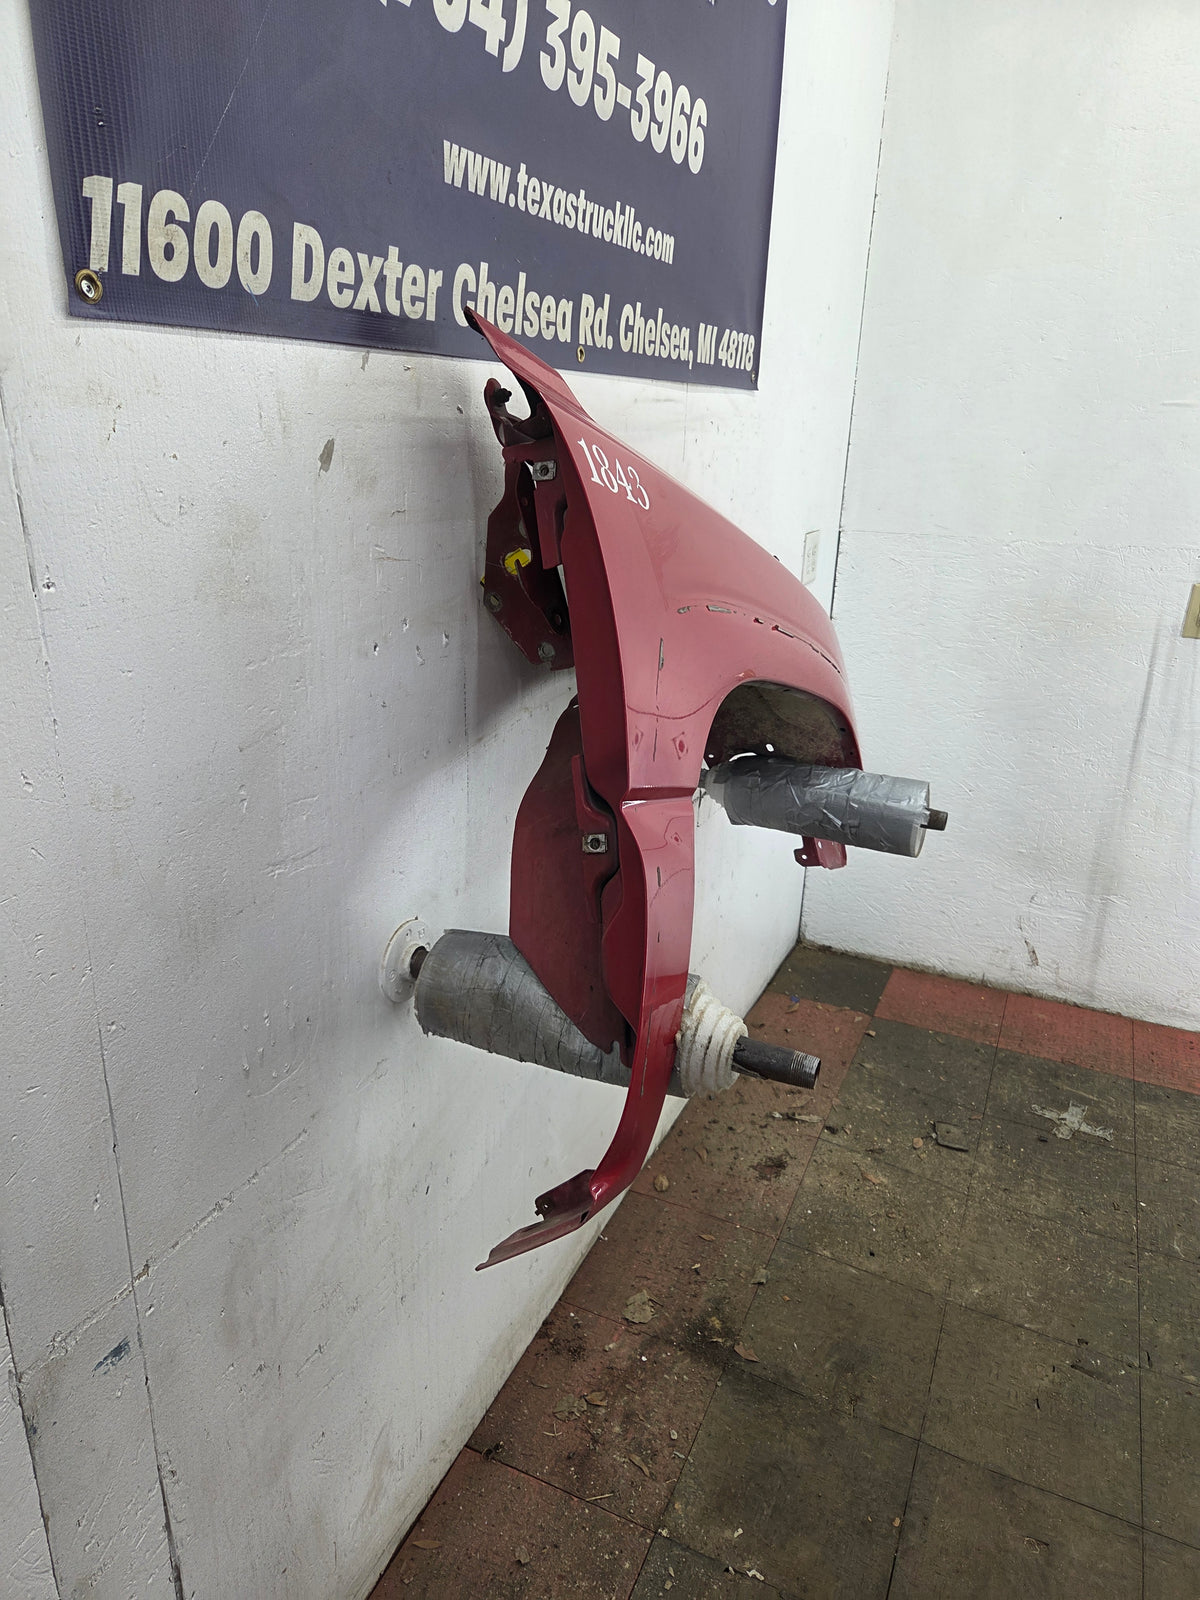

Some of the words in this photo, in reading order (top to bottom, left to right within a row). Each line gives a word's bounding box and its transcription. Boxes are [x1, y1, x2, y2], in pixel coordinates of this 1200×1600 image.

[540, 0, 708, 174] 395-3966
[82, 175, 273, 295] 11600
[291, 222, 443, 321] Dexter
[452, 261, 574, 343] Chelsea
[579, 293, 613, 350] Rd.
[619, 302, 694, 370] Chelsea,
[697, 322, 718, 366] MI
[718, 328, 756, 372] 48118
[443, 139, 675, 265] www.texastruckllc.com
[577, 438, 651, 510] 1843
